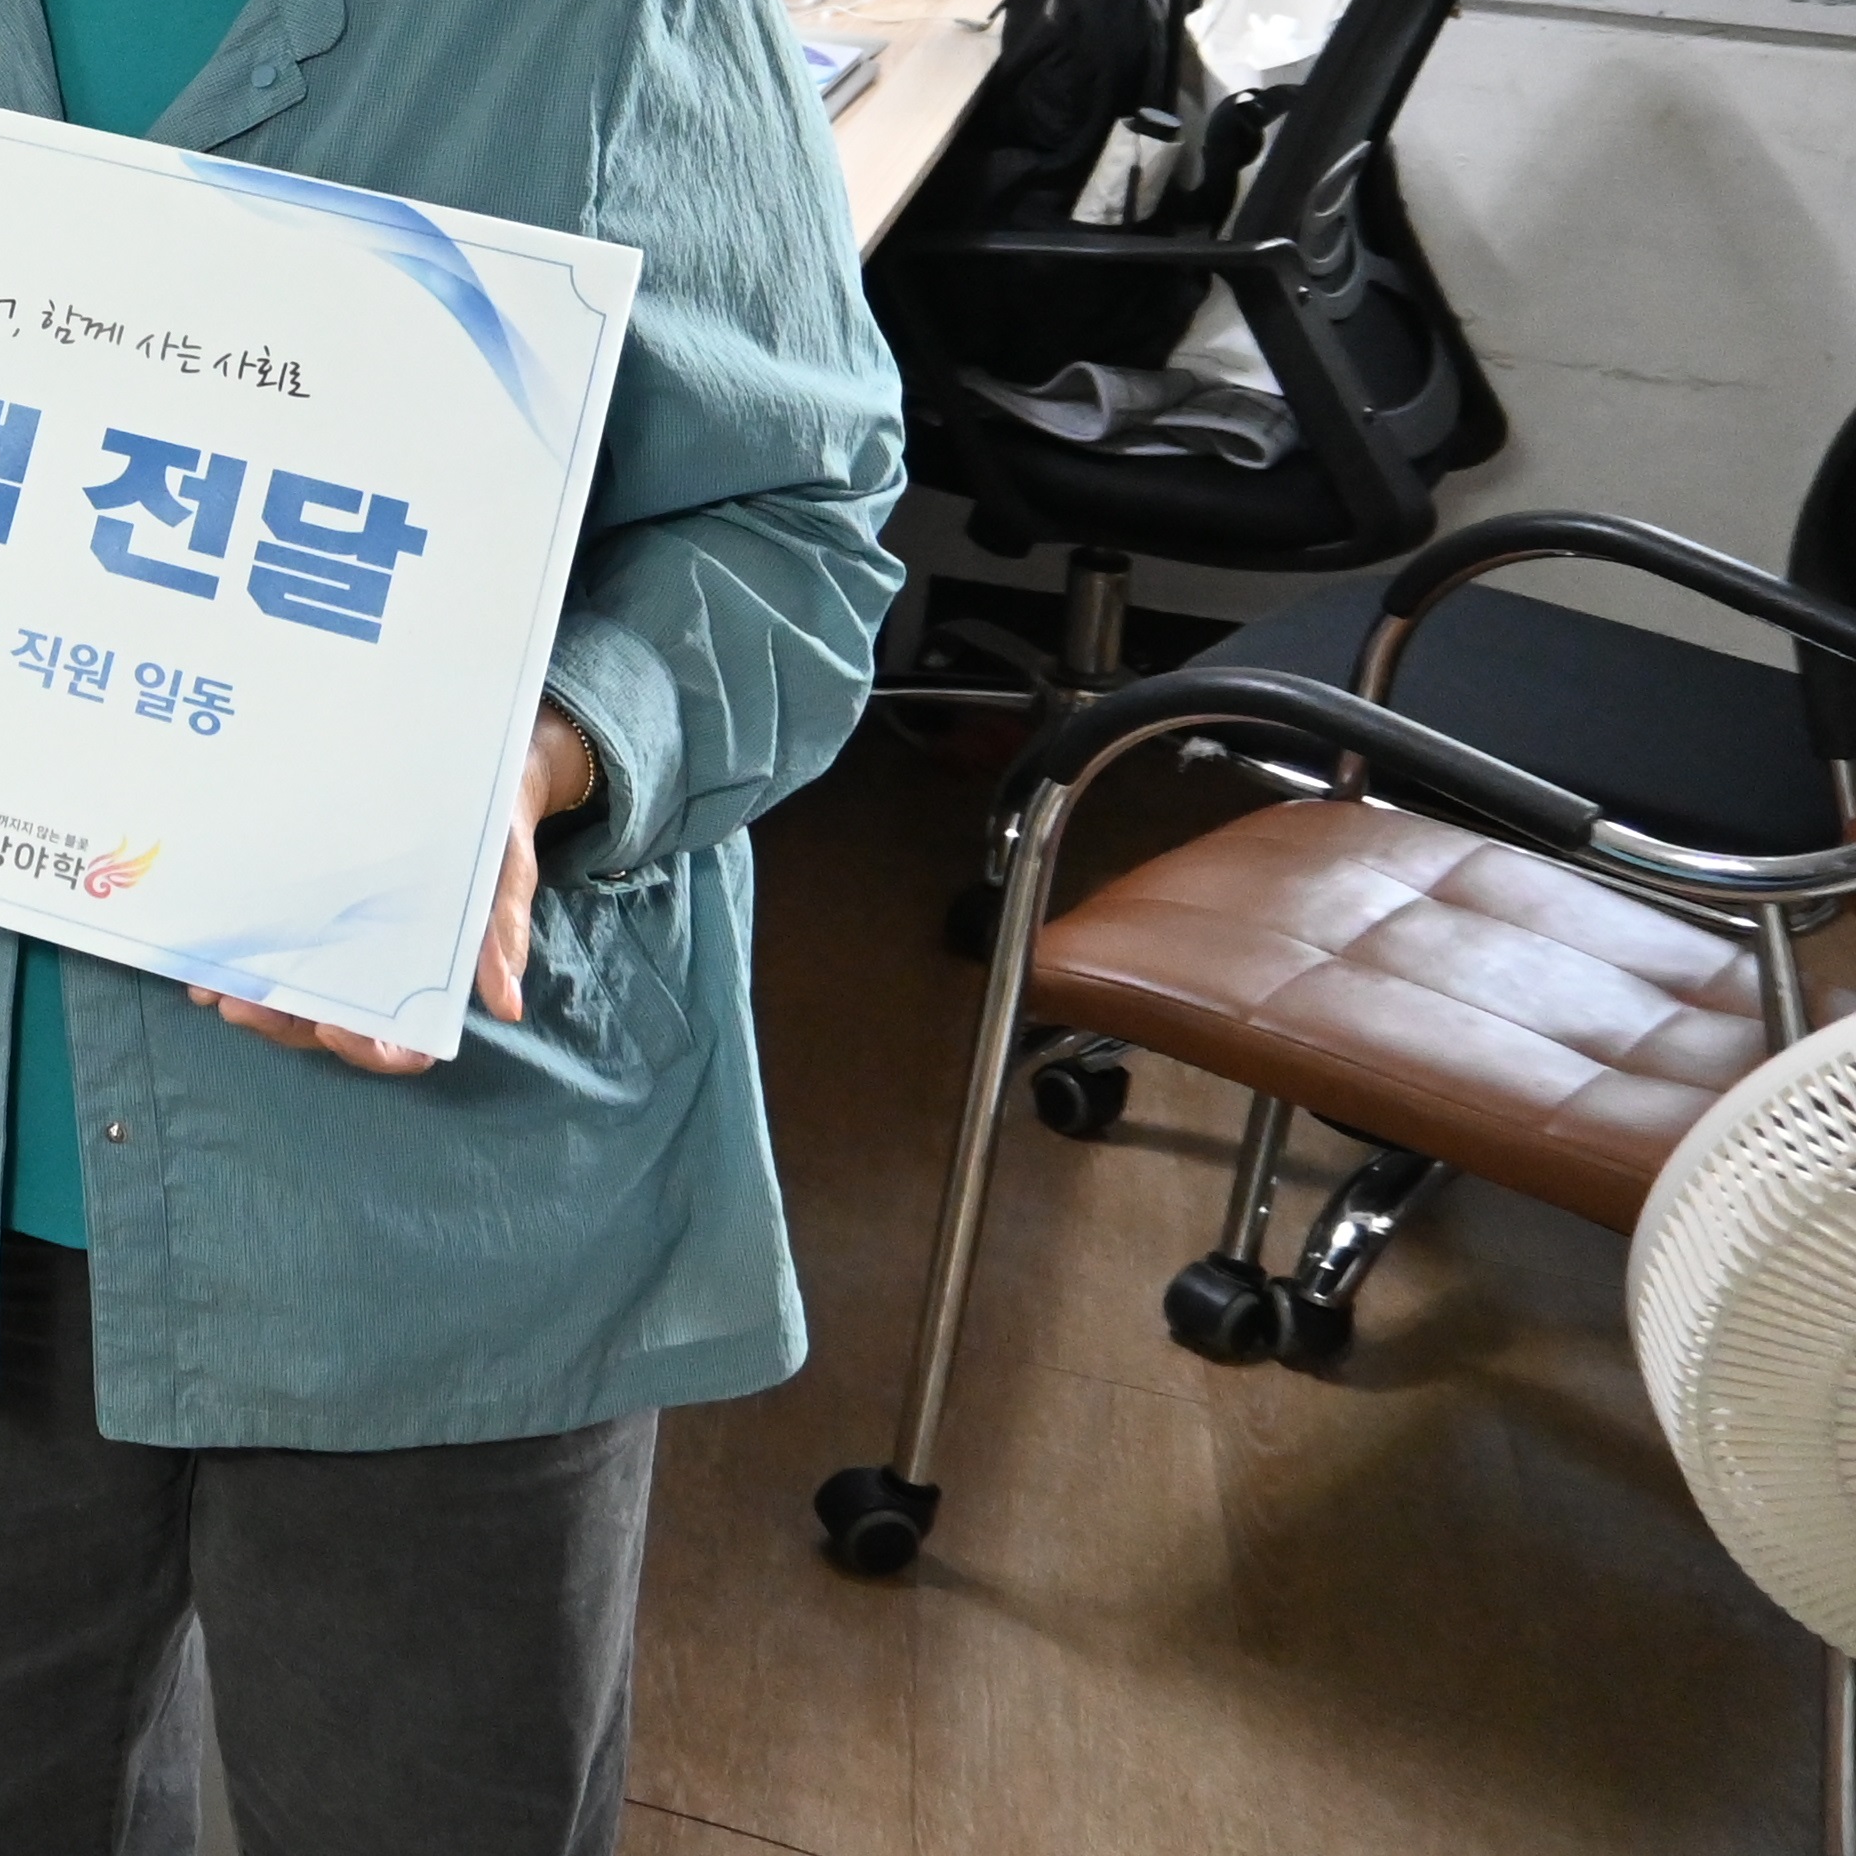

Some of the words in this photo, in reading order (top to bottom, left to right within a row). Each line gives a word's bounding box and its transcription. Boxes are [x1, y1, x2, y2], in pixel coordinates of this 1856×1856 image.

[41, 299, 124, 345] 함께
[136, 331, 202, 374] 사는
[213, 345, 311, 398] 사회로
[82, 426, 428, 644] 전달
[10, 622, 115, 705] 직원
[132, 659, 237, 738] 일동
[36, 825, 62, 845] 않는
